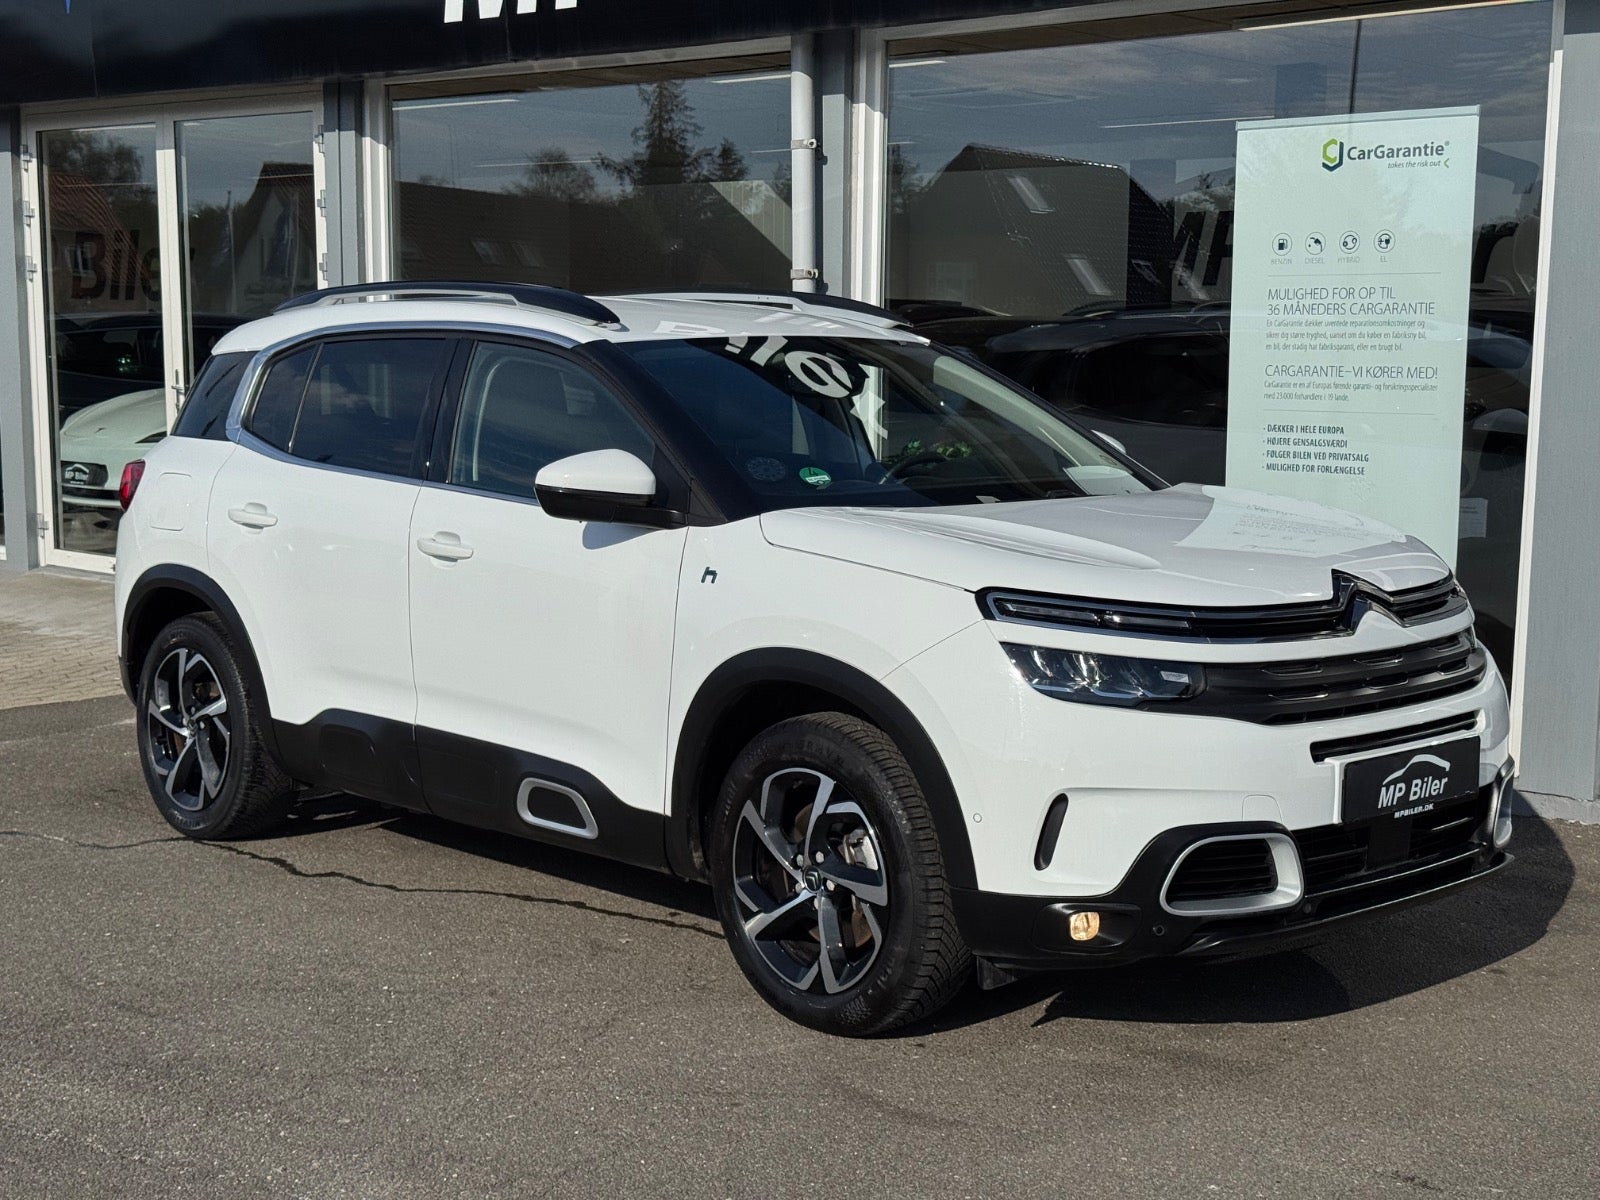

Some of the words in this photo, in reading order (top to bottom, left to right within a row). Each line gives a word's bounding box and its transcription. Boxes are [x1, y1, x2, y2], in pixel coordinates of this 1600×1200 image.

[1338, 256, 1360, 264] HYBRID
[1268, 287, 1329, 300] MULIGHED
[1332, 286, 1355, 300] FOR
[1358, 286, 1376, 300] OP
[1380, 286, 1396, 299] TIL
[1267, 304, 1280, 316] 36
[1283, 301, 1346, 316] MÅNEDERS
[1350, 302, 1436, 316] CARGARANTIE
[1417, 320, 1425, 328] og
[1378, 343, 1393, 352] brugt
[1366, 365, 1404, 379] KØRER
[1406, 366, 1438, 380] MED!
[1264, 392, 1276, 400] med
[1267, 424, 1294, 434] DÆKKER
[1300, 425, 1317, 434] HELE
[1318, 426, 1344, 434] EUROPA
[1266, 438, 1291, 446] HØJERE
[1293, 438, 1348, 448] GENSALGSVÆRDI
[1266, 450, 1291, 460] FØLGER
[1292, 450, 1312, 460] BILEN
[1314, 452, 1327, 461] VED
[1328, 452, 1370, 462] PRIVATSALG
[1266, 463, 1300, 472] MULIGHED
[1302, 464, 1315, 473] FOR
[1317, 465, 1366, 476] FORLÆNGELSE
[1378, 782, 1406, 809] MP
[1409, 776, 1448, 801] Biler
[1394, 803, 1434, 818] MPBILER.DK
